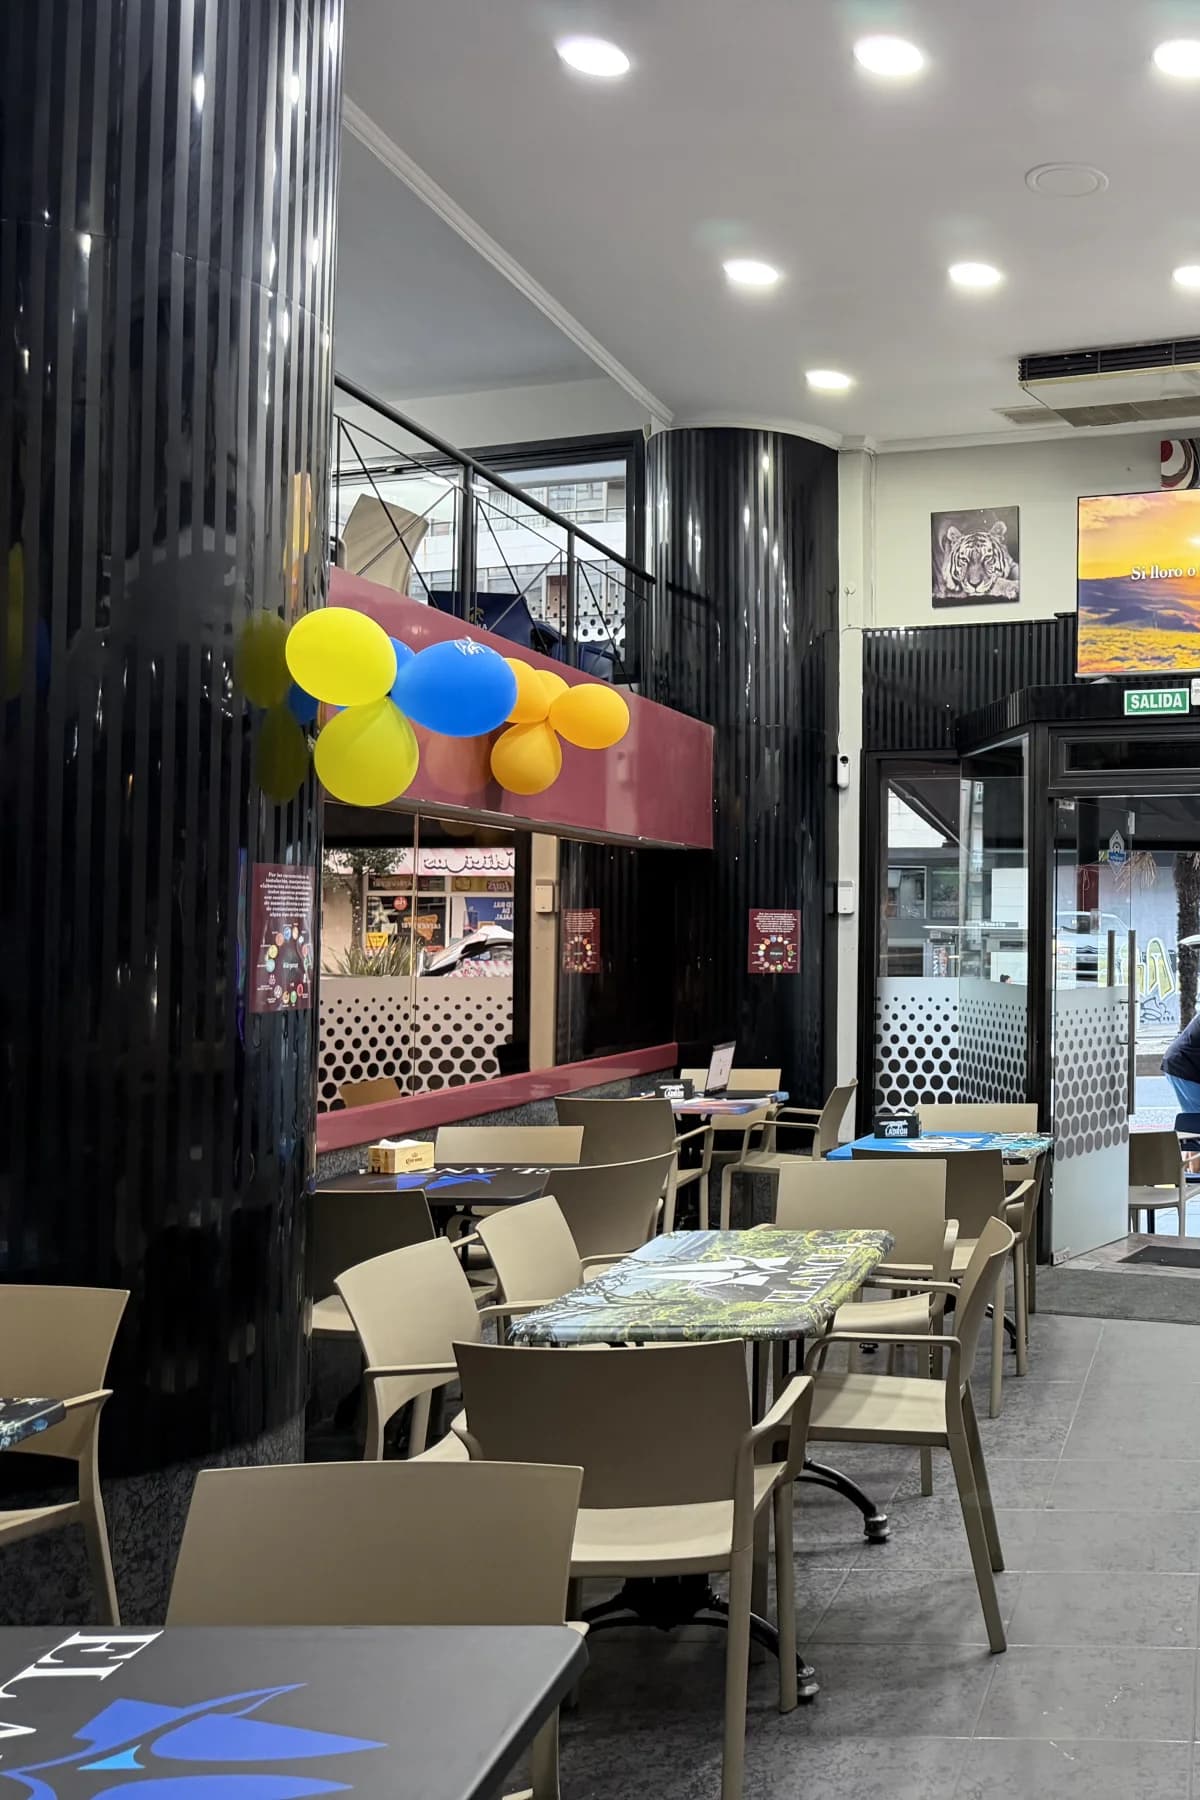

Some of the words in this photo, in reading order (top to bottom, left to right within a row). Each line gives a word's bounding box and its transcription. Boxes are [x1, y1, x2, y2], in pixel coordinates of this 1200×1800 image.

[1130, 567, 1146, 581] Si
[1150, 565, 1183, 580] lloro
[1187, 568, 1196, 578] o
[1131, 693, 1183, 709] SALIDA
